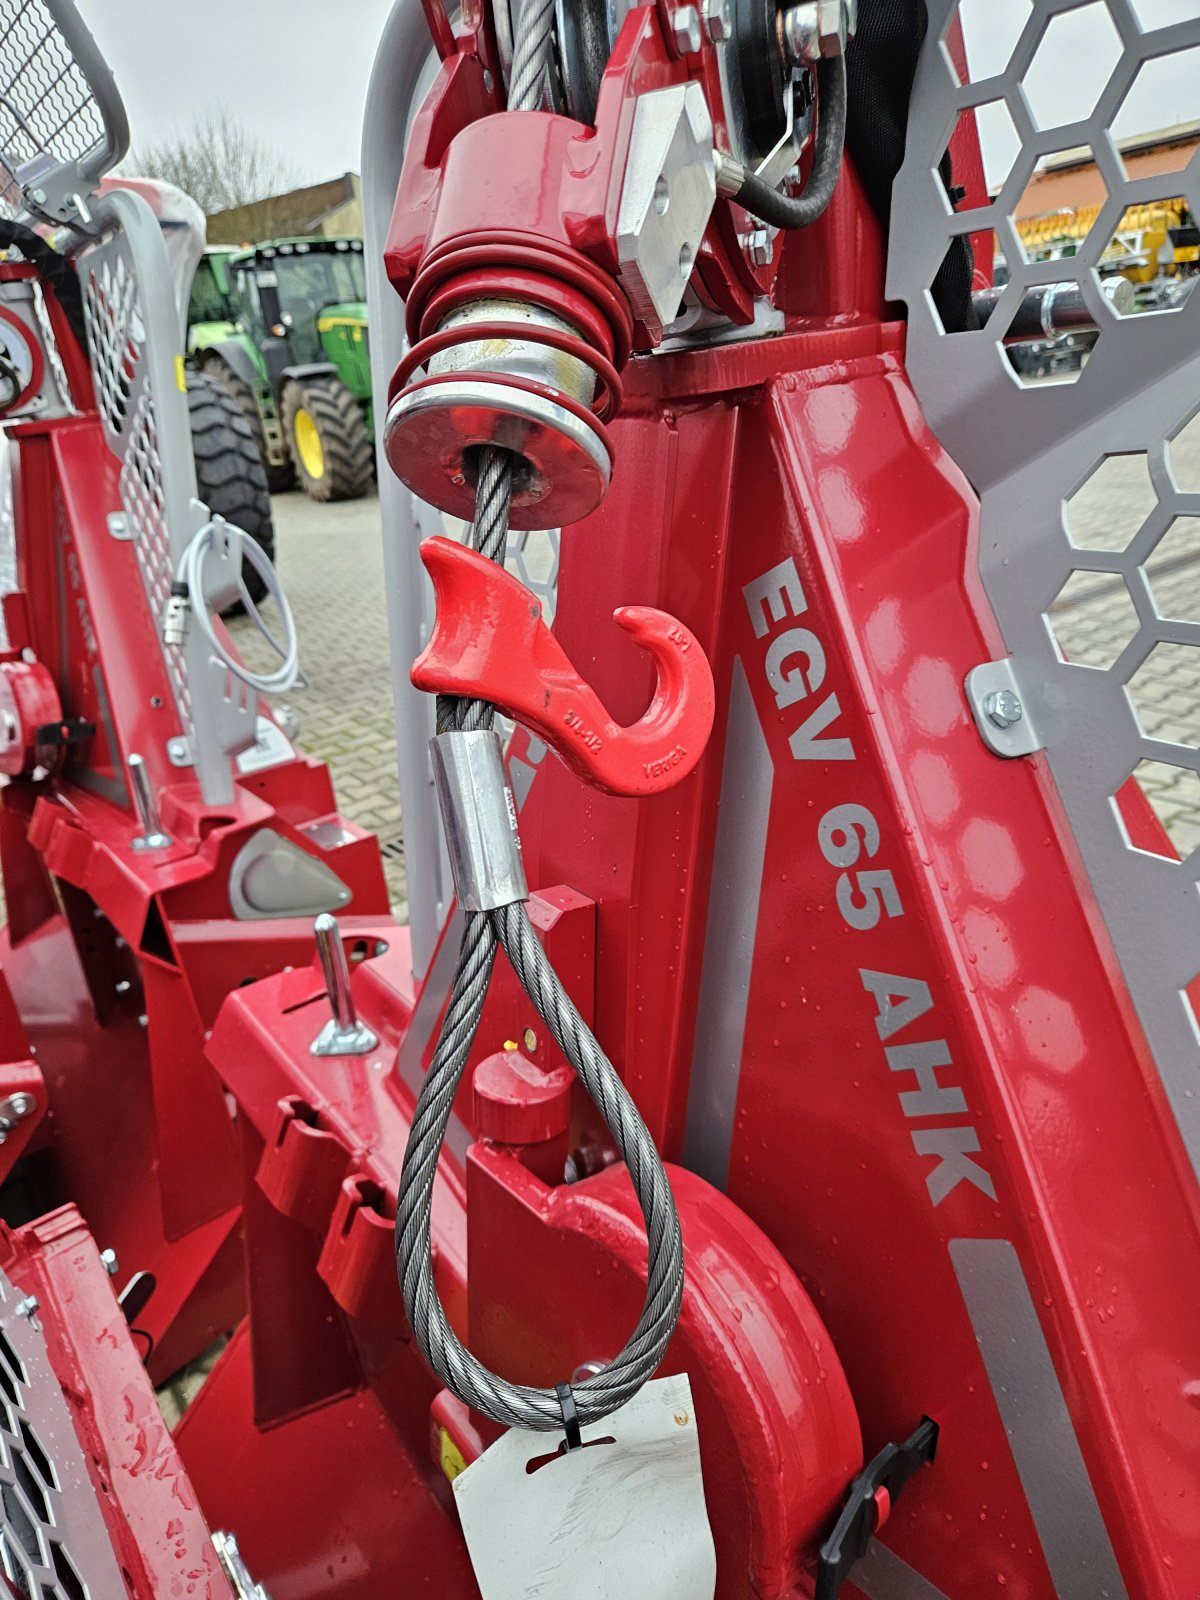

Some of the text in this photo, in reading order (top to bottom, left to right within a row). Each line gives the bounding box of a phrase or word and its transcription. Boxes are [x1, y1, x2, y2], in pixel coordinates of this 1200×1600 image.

[742, 556, 998, 1208] EGV 65 AHK
